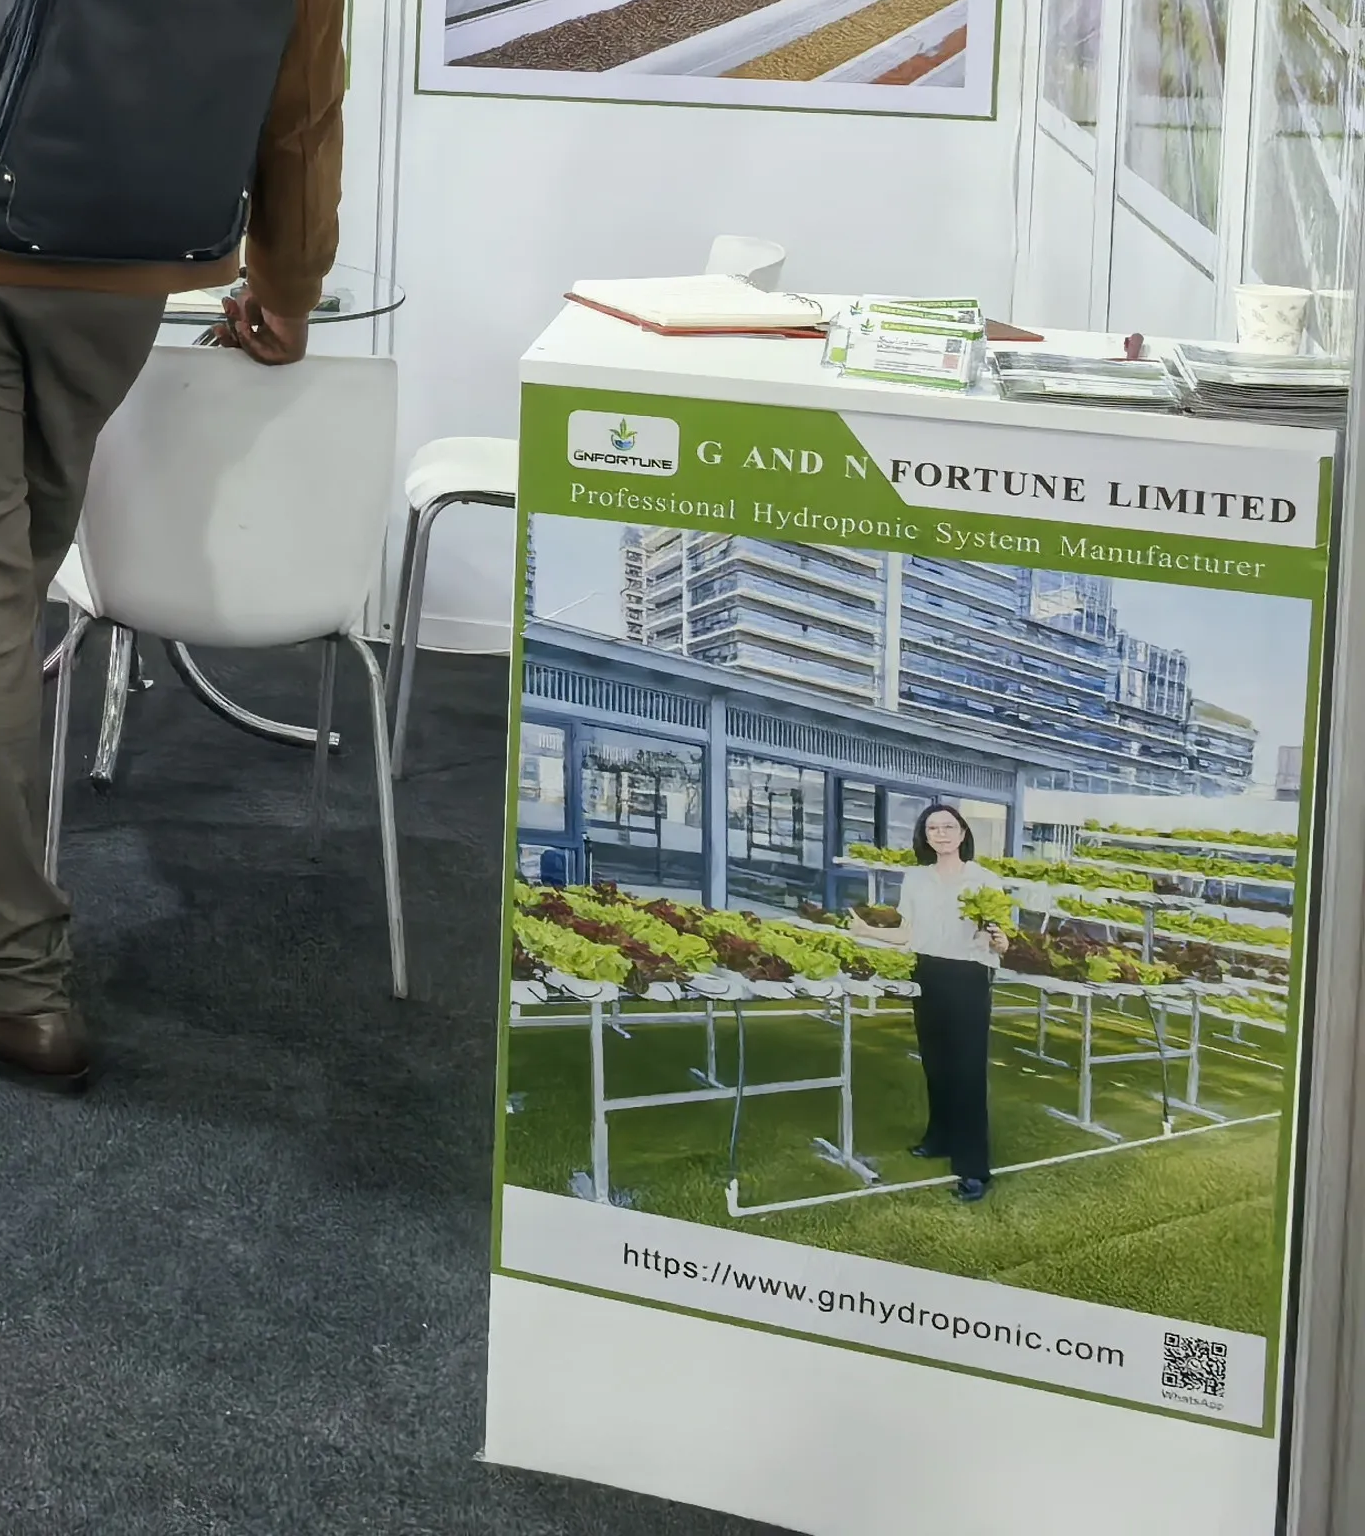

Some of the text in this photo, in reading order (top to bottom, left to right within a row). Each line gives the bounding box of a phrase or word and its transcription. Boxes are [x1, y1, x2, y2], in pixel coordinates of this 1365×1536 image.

[573, 448, 673, 472] GNFORTUNE
[696, 440, 1297, 524] G AND N FORTUNE LIMITED
[570, 483, 1267, 579] Professional Hydroponic System Manufacturer
[623, 1242, 1126, 1368] https://www.gnhydroponic.com
[1162, 1389, 1224, 1411] WhatsApp
